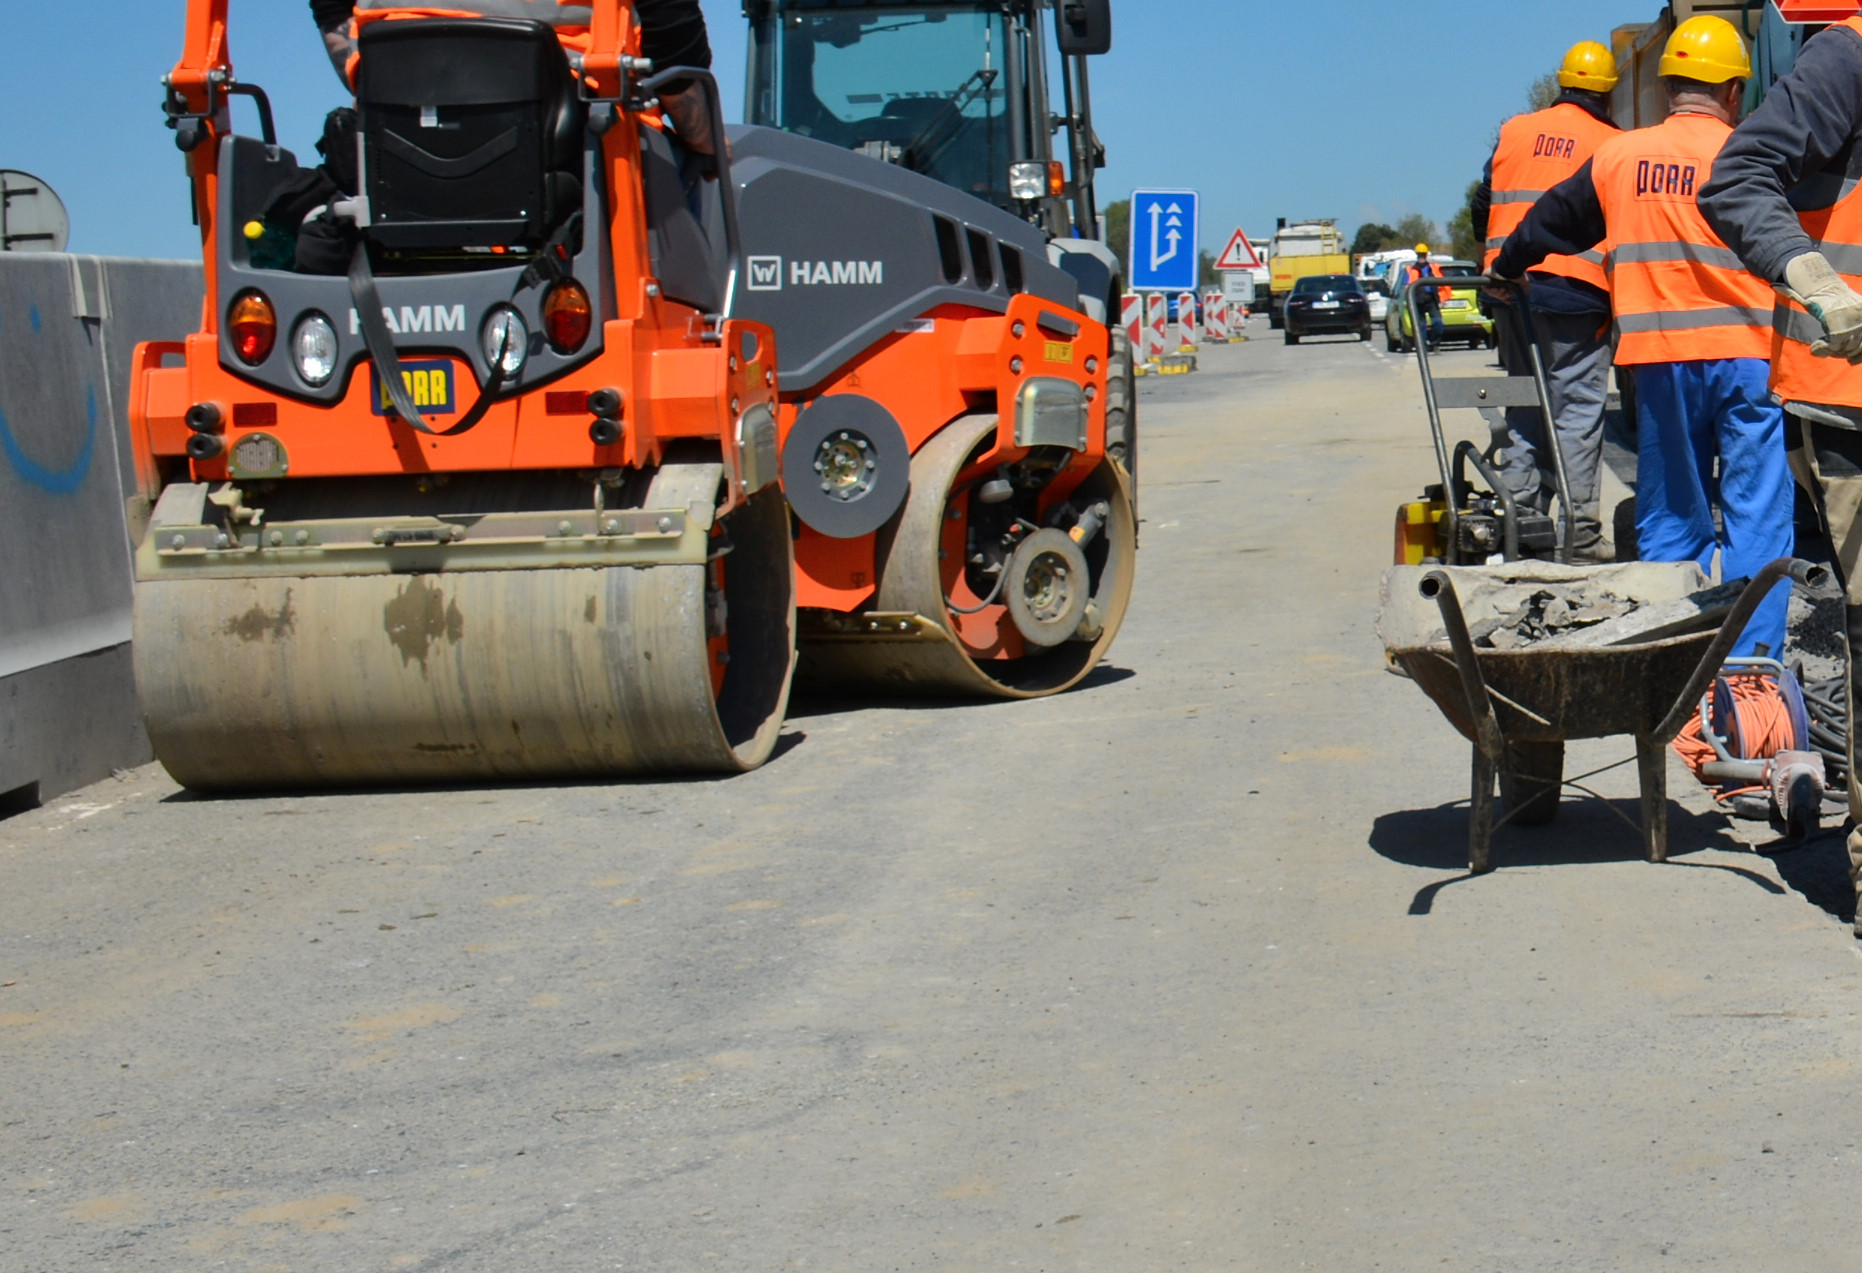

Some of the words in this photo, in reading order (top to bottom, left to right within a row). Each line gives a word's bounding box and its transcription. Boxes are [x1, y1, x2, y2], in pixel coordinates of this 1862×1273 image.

[1533, 133, 1575, 159] PORR
[1637, 160, 1695, 197] PORR
[790, 260, 883, 285] HAMM
